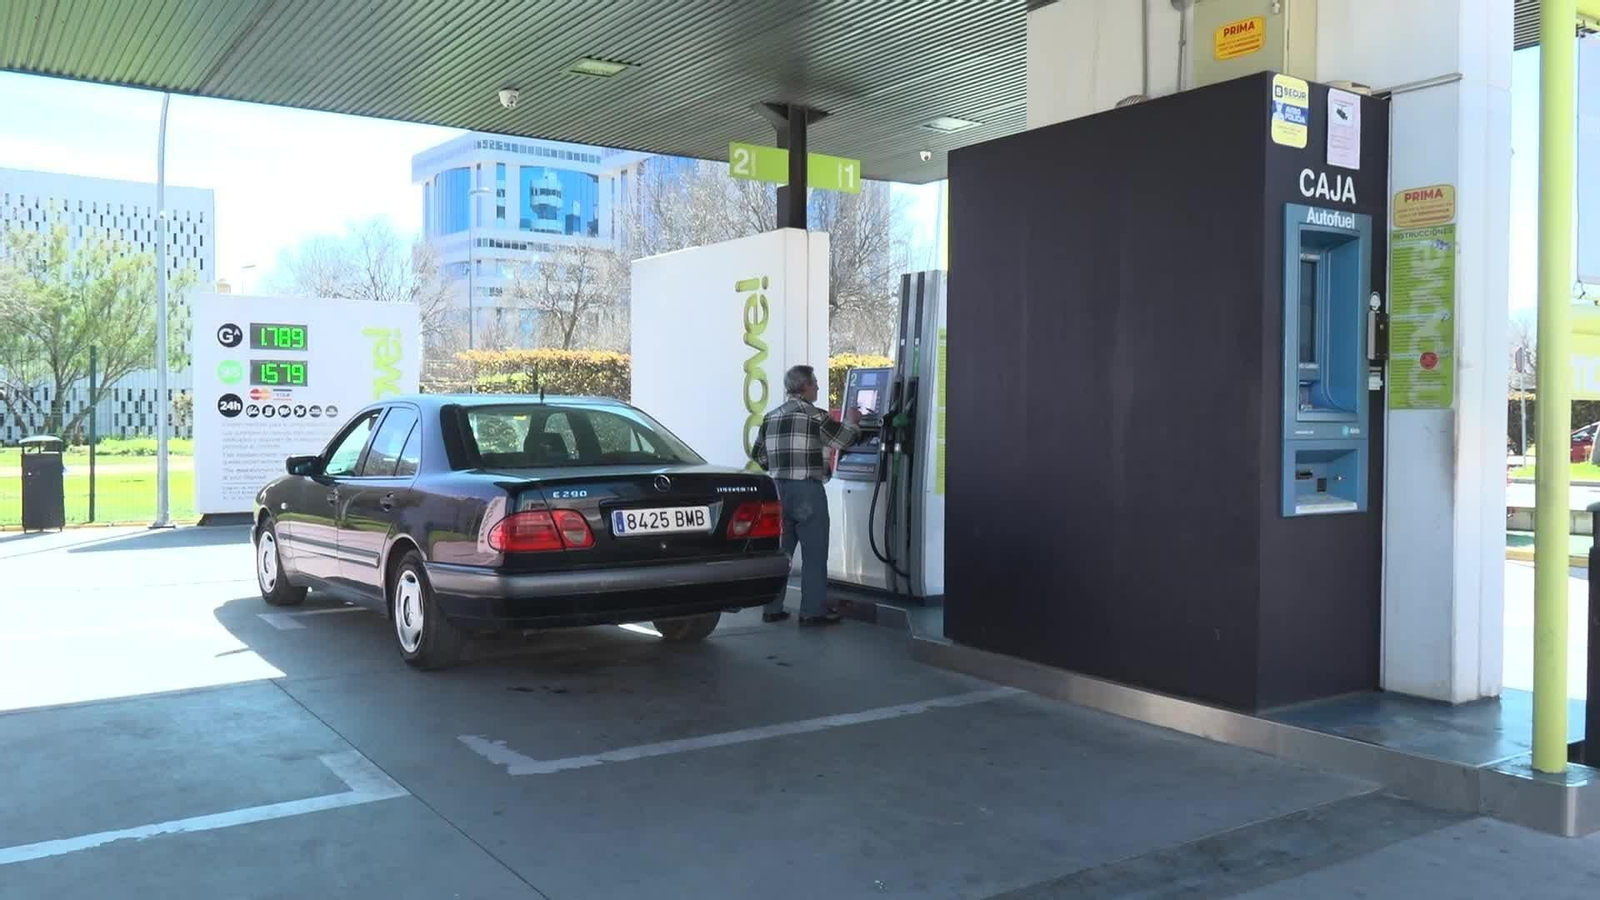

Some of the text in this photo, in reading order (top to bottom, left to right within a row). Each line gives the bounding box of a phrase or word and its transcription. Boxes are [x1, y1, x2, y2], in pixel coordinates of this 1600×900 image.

[1223, 20, 1256, 38] PRIMA
[1299, 168, 1357, 205] CAJA
[1403, 187, 1444, 203] PRIMA
[1306, 206, 1356, 230] Autofuel
[850, 372, 858, 387] 2
[219, 400, 241, 411] 24h
[626, 509, 705, 530] 8425 BMB
